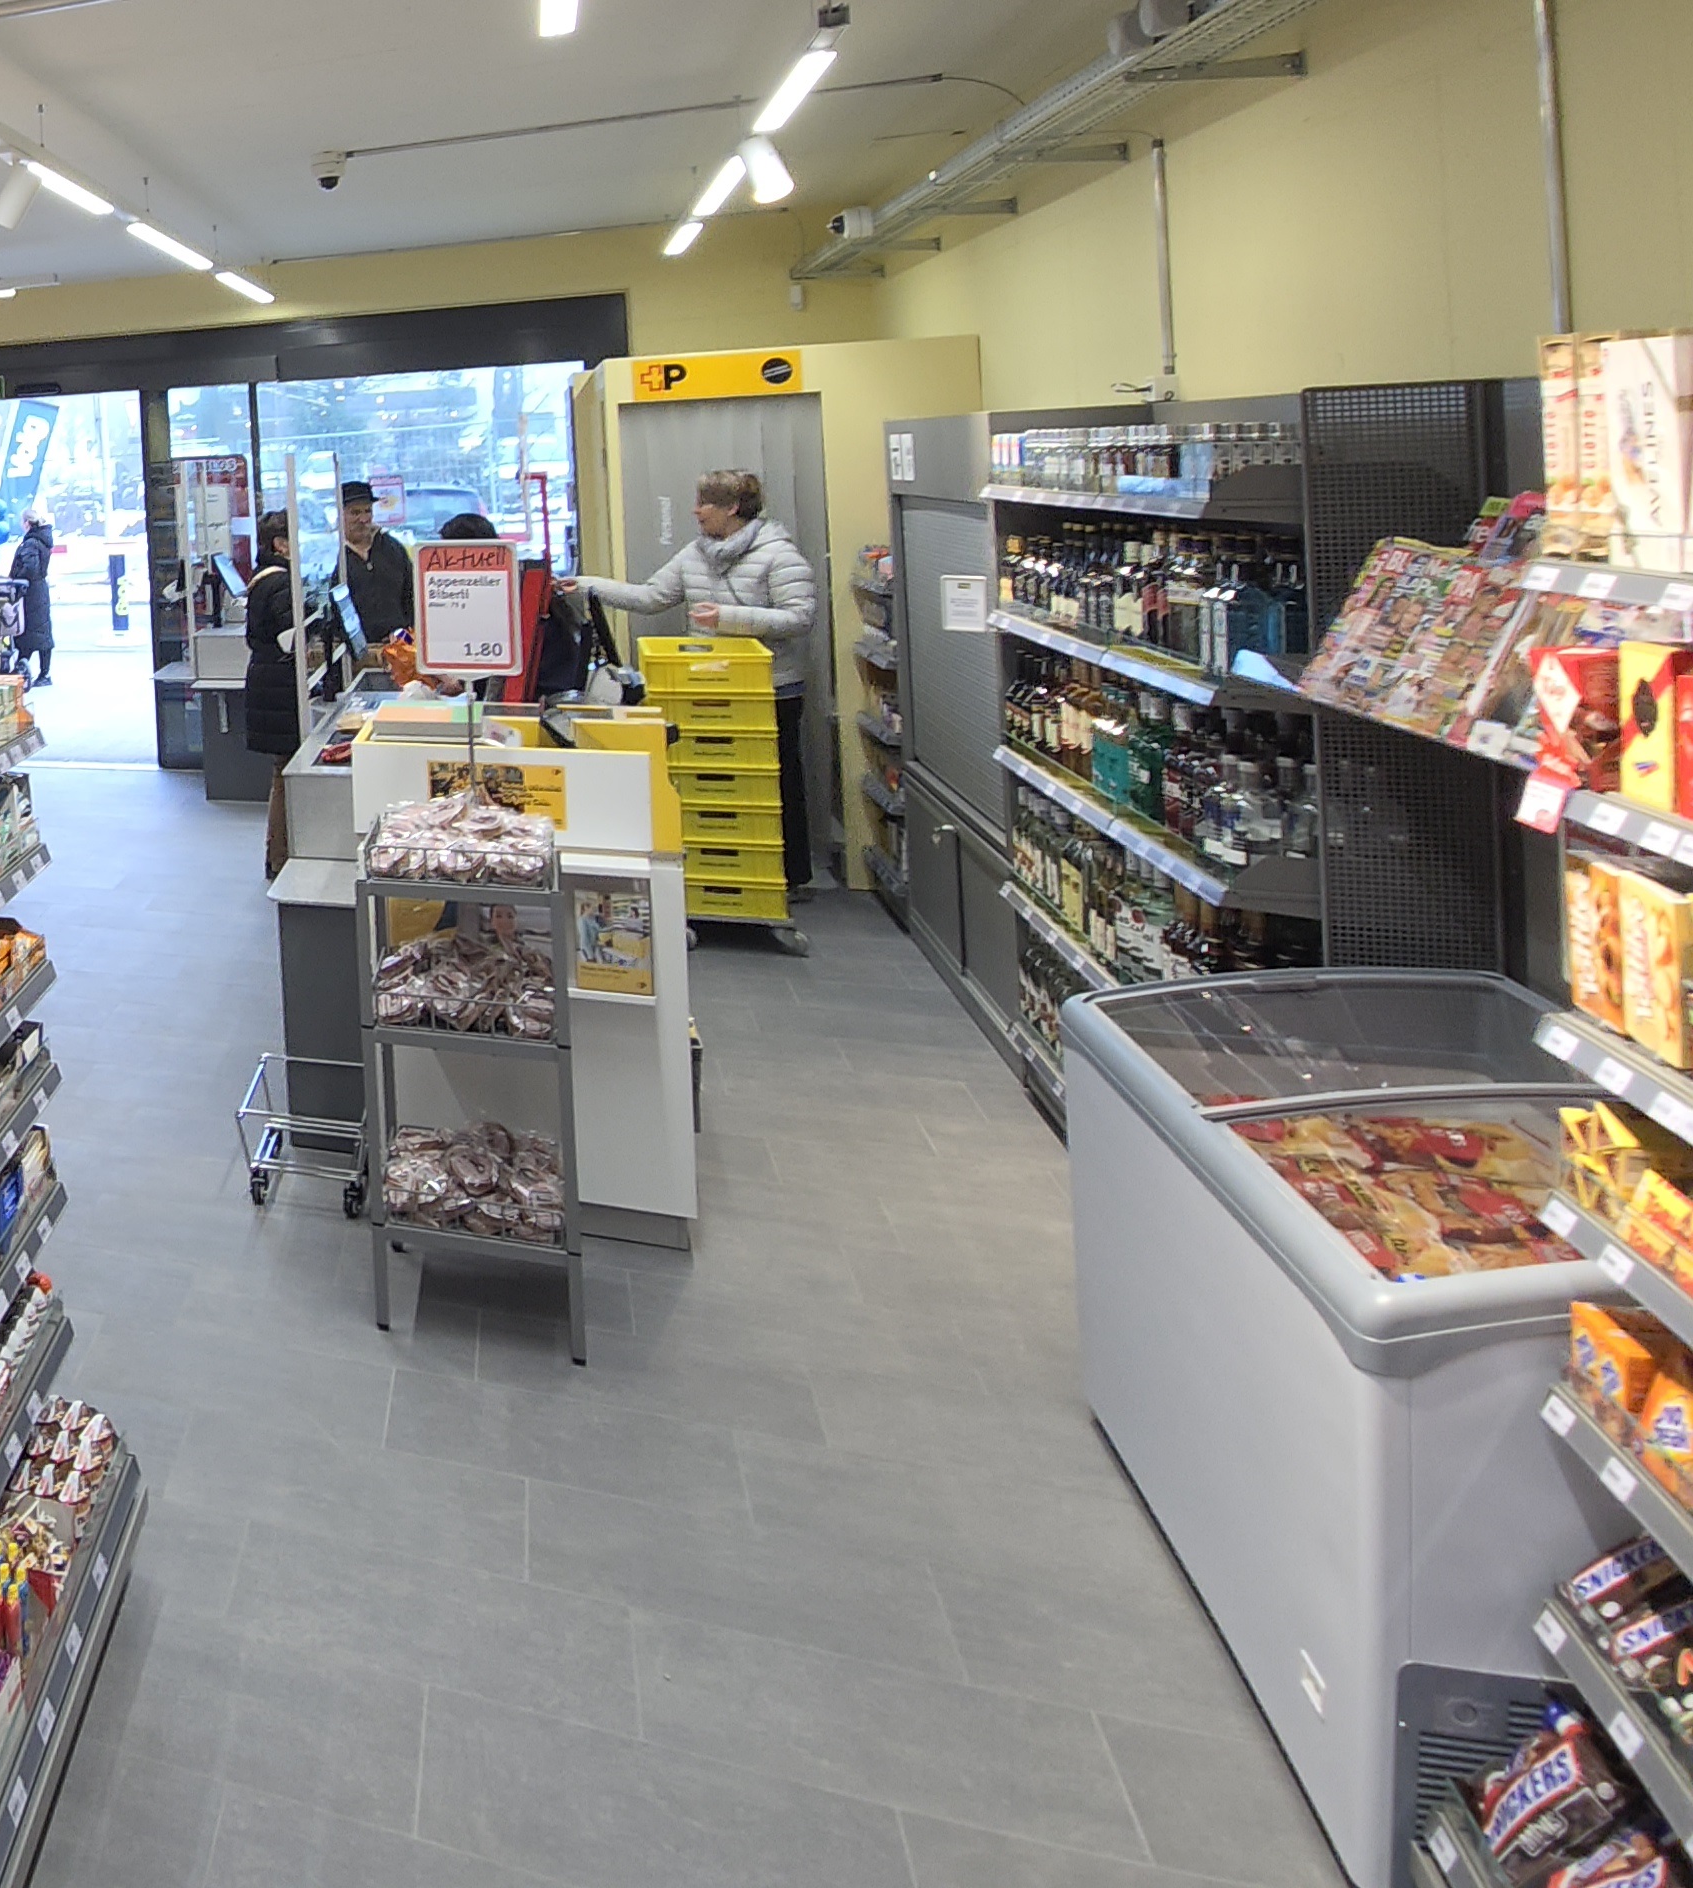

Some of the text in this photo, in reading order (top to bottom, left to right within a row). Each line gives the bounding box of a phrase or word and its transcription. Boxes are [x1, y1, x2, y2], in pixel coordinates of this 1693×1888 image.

[1641, 381, 1663, 527] AVELINES
[428, 548, 506, 570] Aktuell
[428, 576, 501, 589] Appenzeller
[464, 642, 502, 657] 1.80
